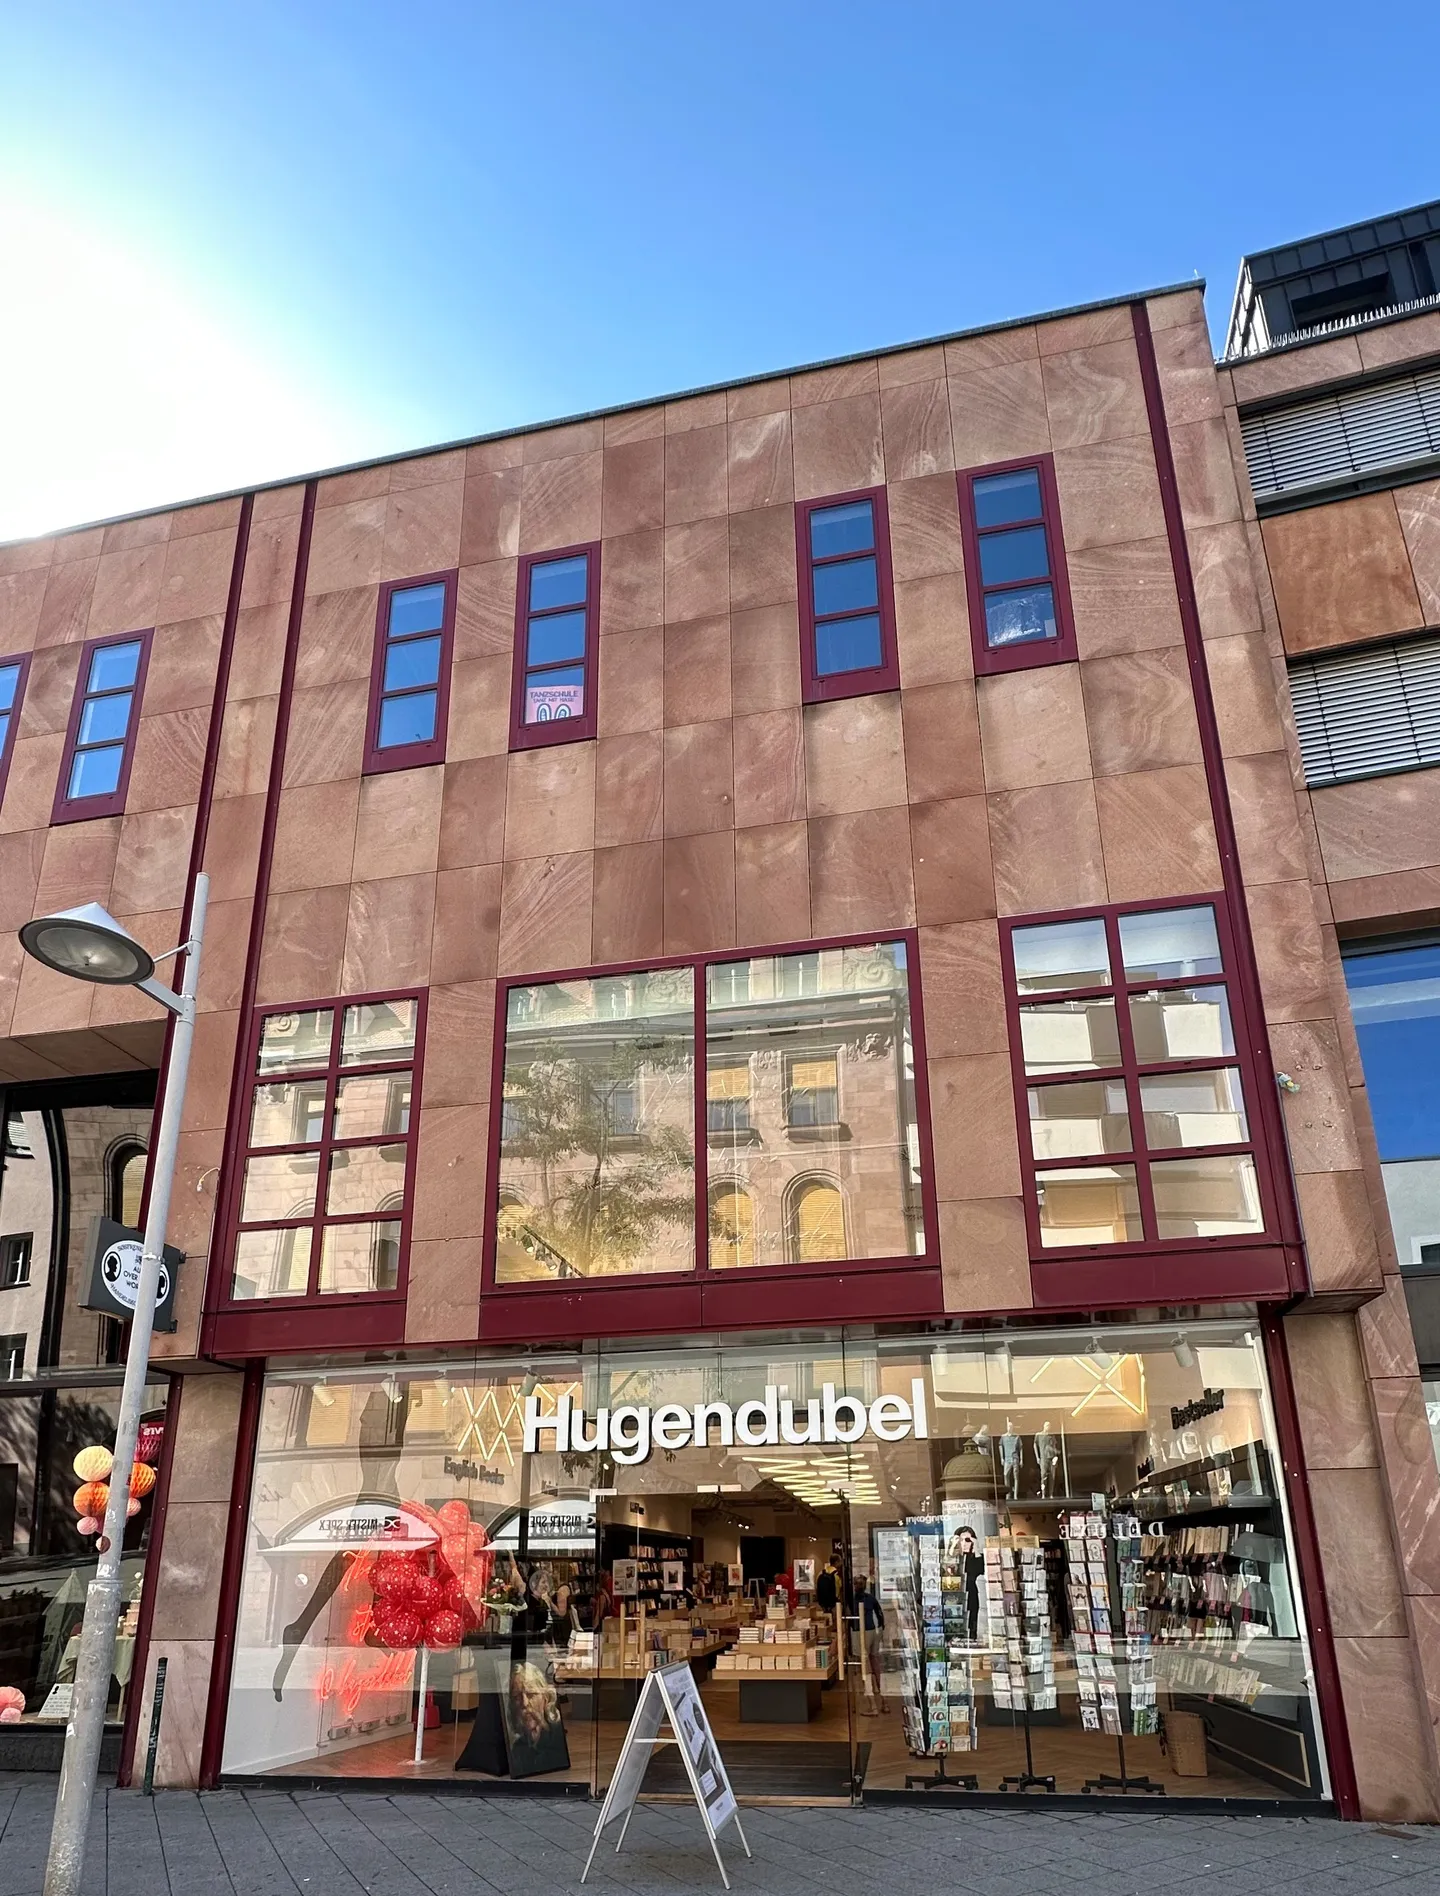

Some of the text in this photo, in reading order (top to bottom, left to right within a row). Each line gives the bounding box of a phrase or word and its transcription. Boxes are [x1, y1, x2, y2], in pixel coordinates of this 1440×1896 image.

[530, 690, 579, 698] TANZSCHULE
[523, 1378, 928, 1465] Hugendubel
[1170, 1388, 1224, 1430] Bestseller
[444, 1456, 478, 1482] English
